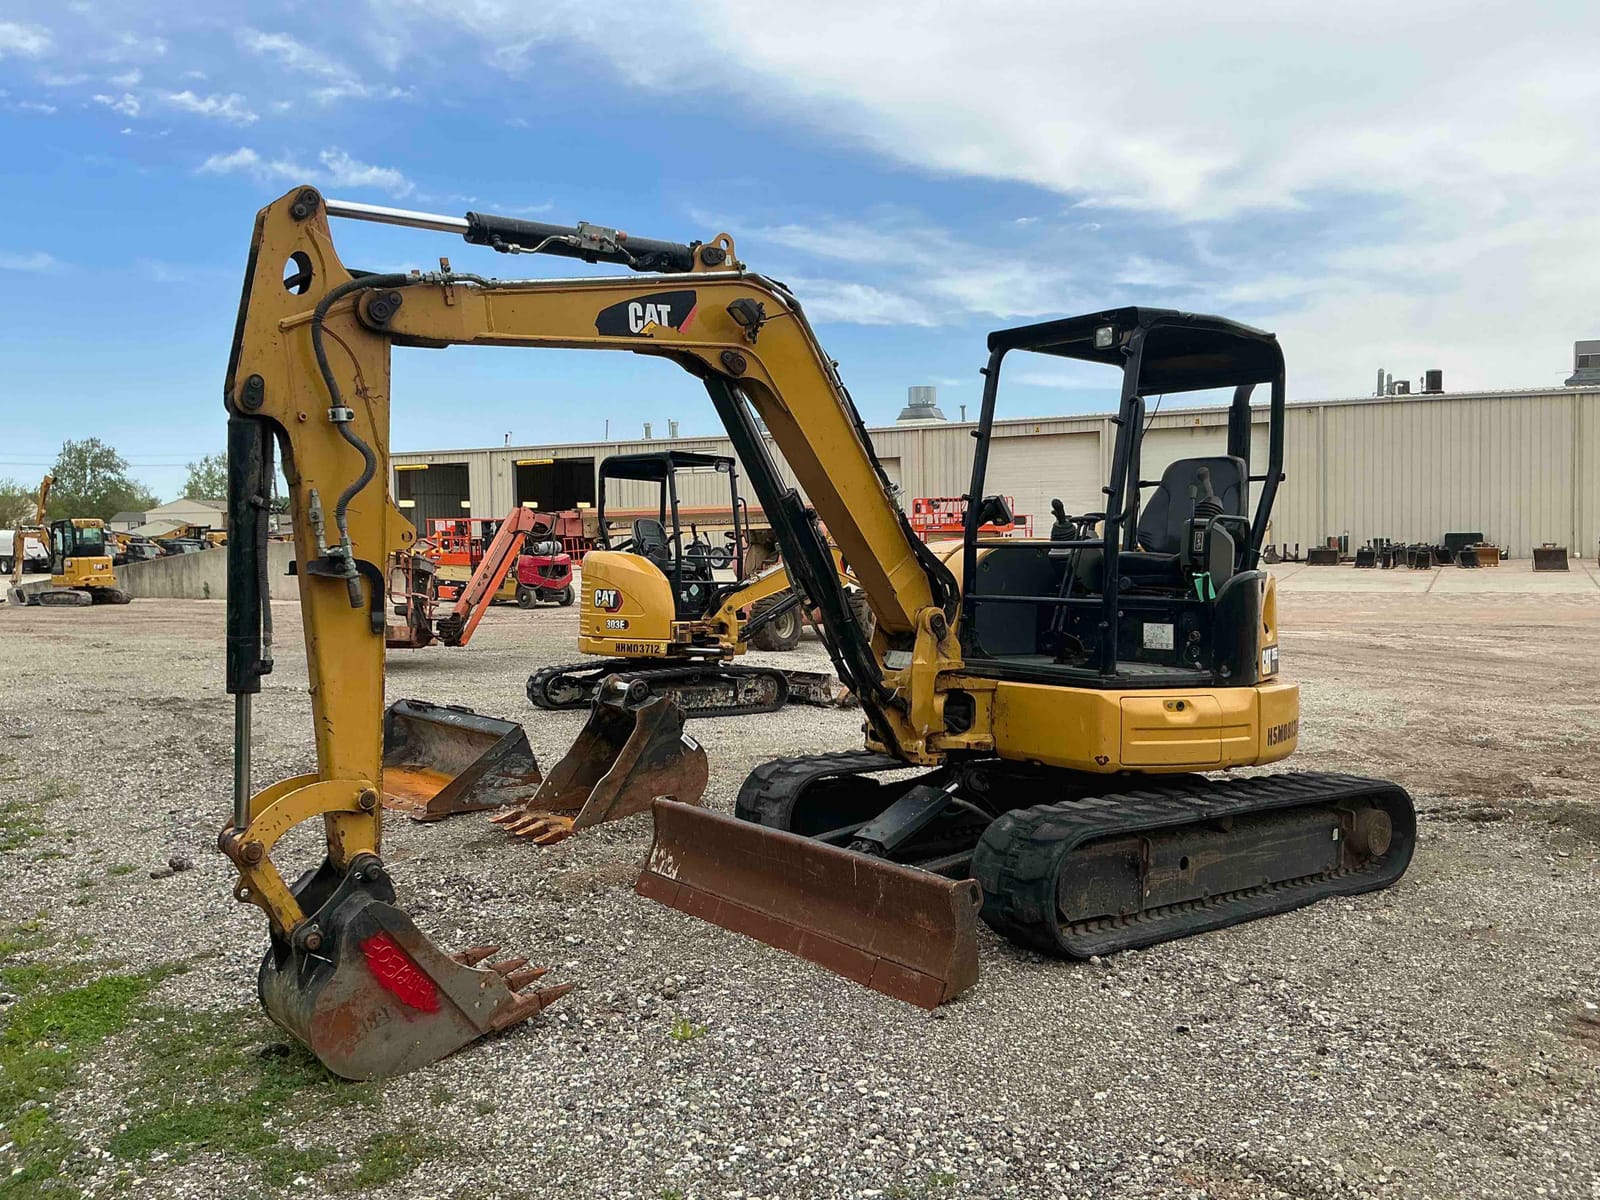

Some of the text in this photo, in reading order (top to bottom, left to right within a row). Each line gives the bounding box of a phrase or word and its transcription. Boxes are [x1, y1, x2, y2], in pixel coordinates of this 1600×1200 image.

[628, 302, 671, 333] CAT
[594, 589, 616, 607] CAT
[606, 619, 625, 629] 303E
